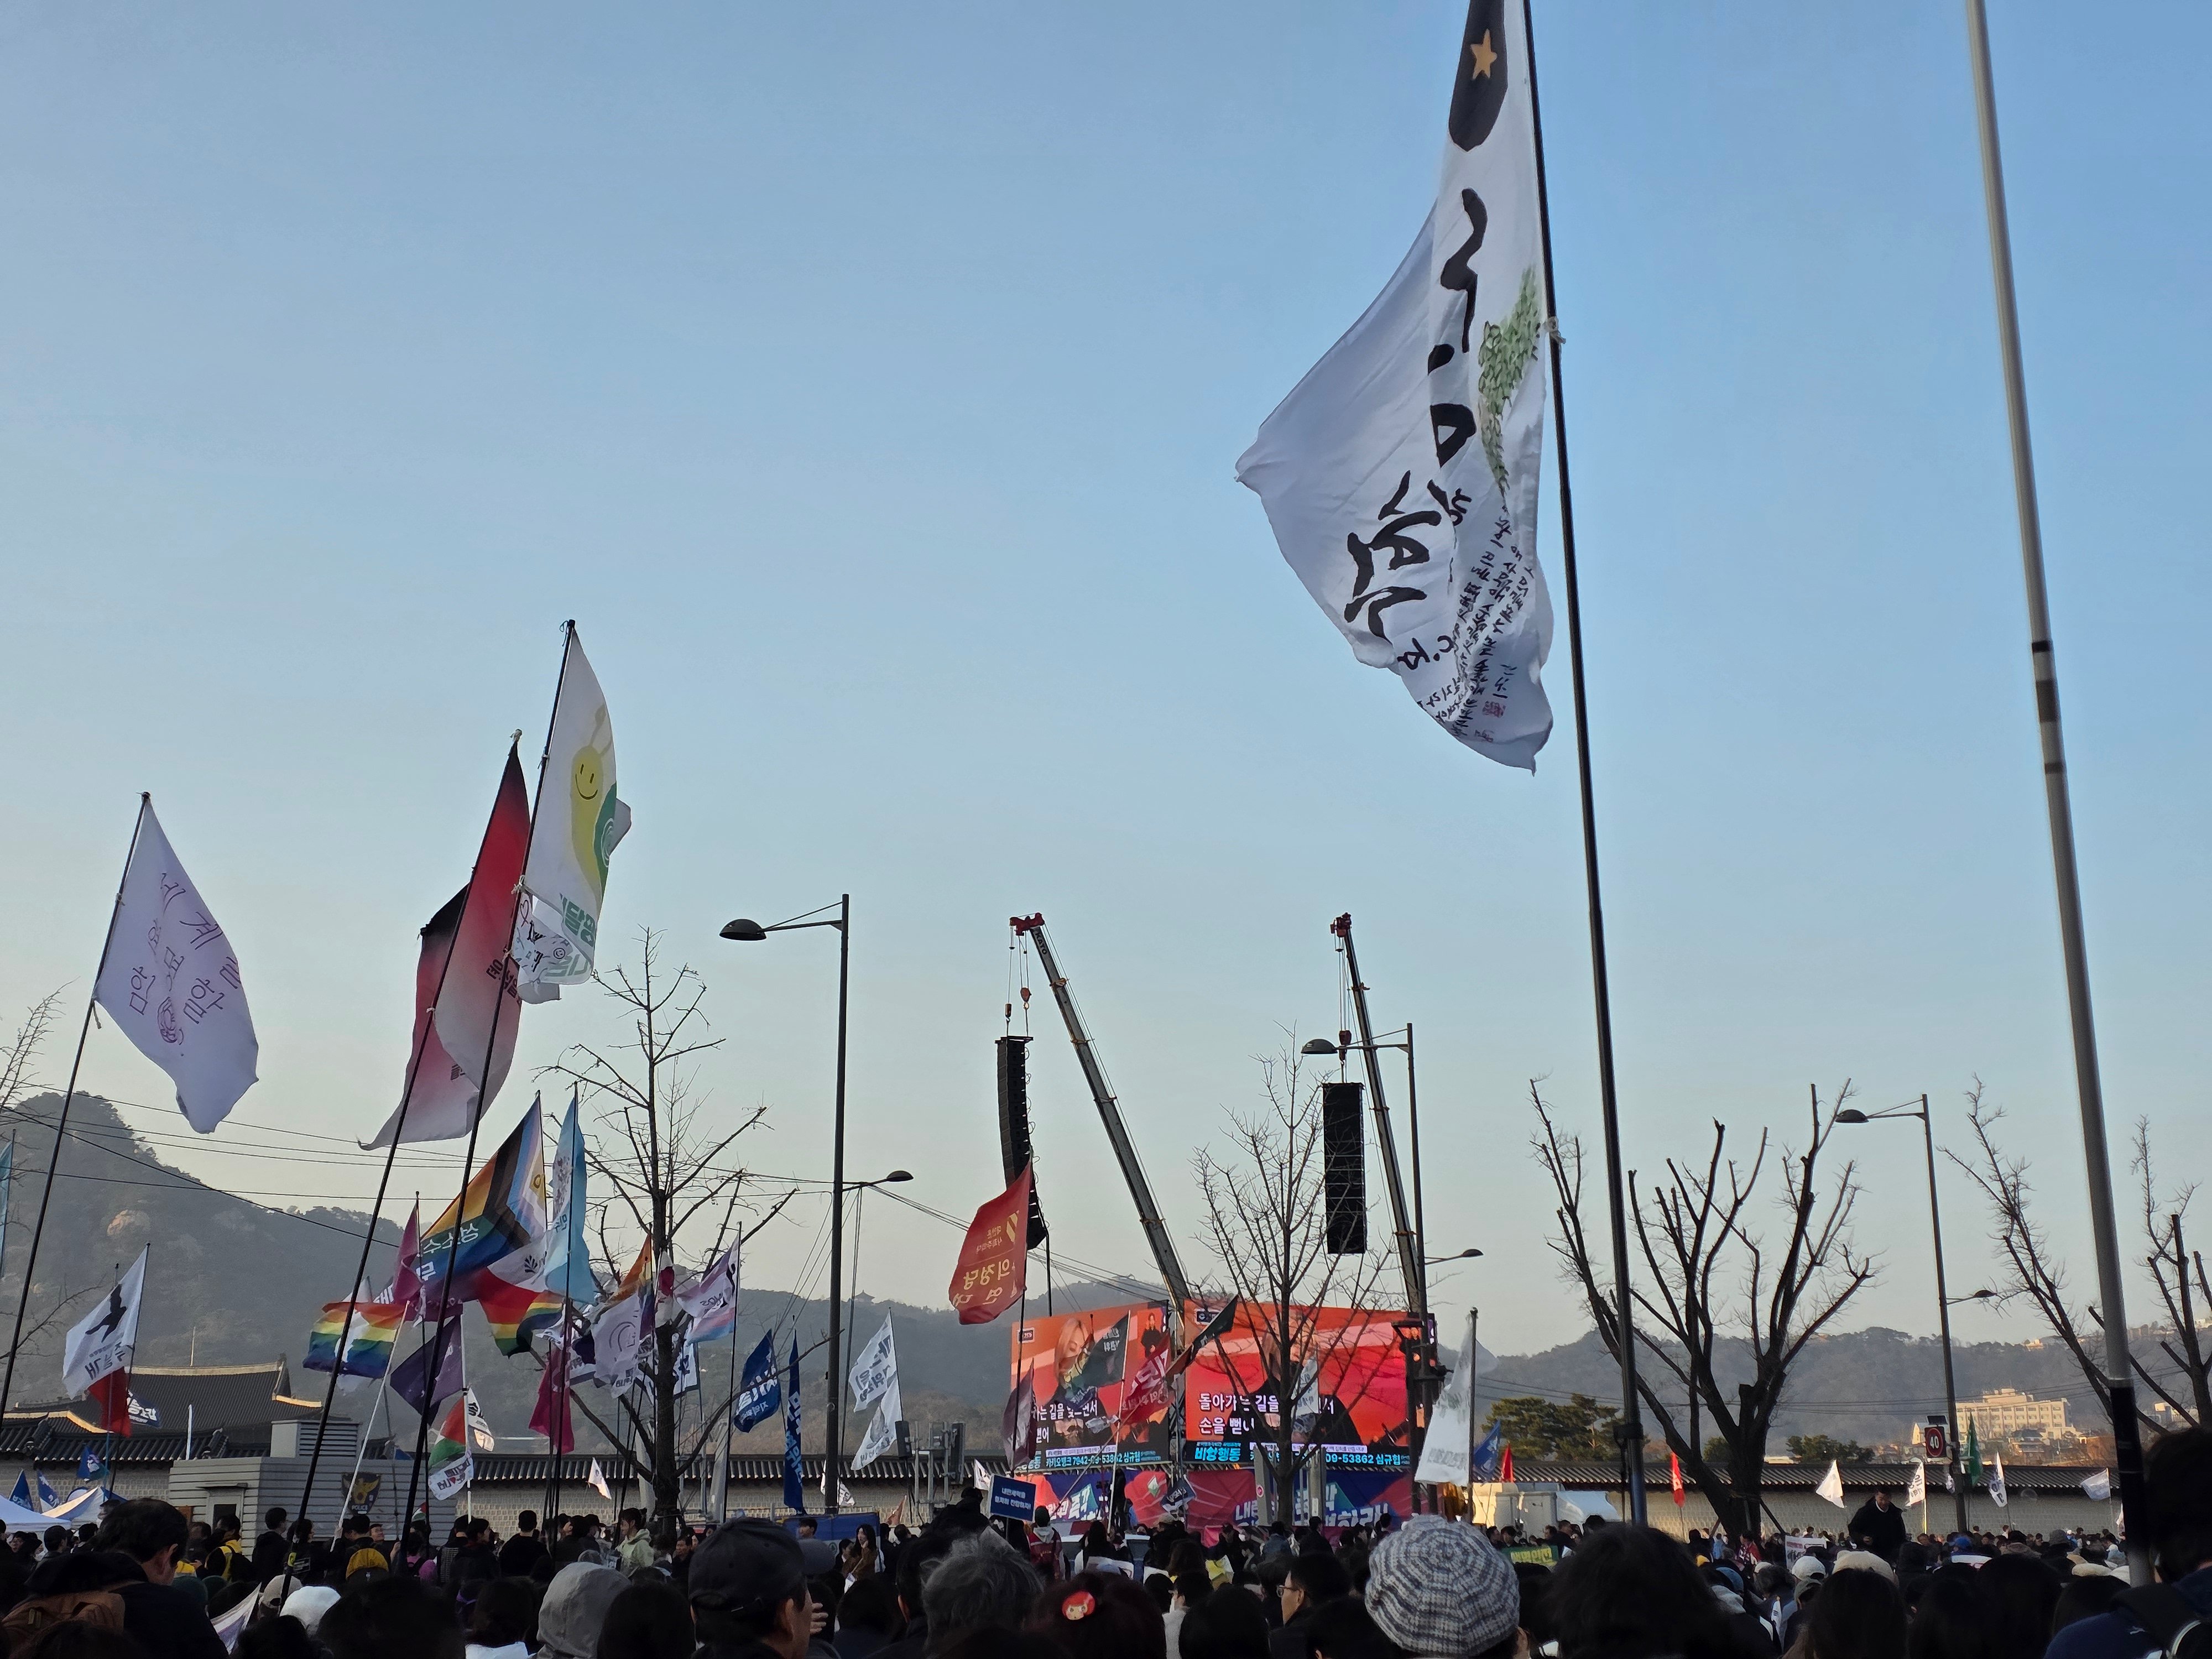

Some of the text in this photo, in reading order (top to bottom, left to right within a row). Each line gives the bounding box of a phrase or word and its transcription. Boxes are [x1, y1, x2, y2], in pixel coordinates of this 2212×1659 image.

[1198, 1392, 1280, 1412] 돌아가는 길을
[1049, 1402, 1065, 1420] 길을
[1198, 1417, 1226, 1434] 손을
[1930, 1436, 1939, 1449] 40
[1194, 1447, 1241, 1462] 비상행동
